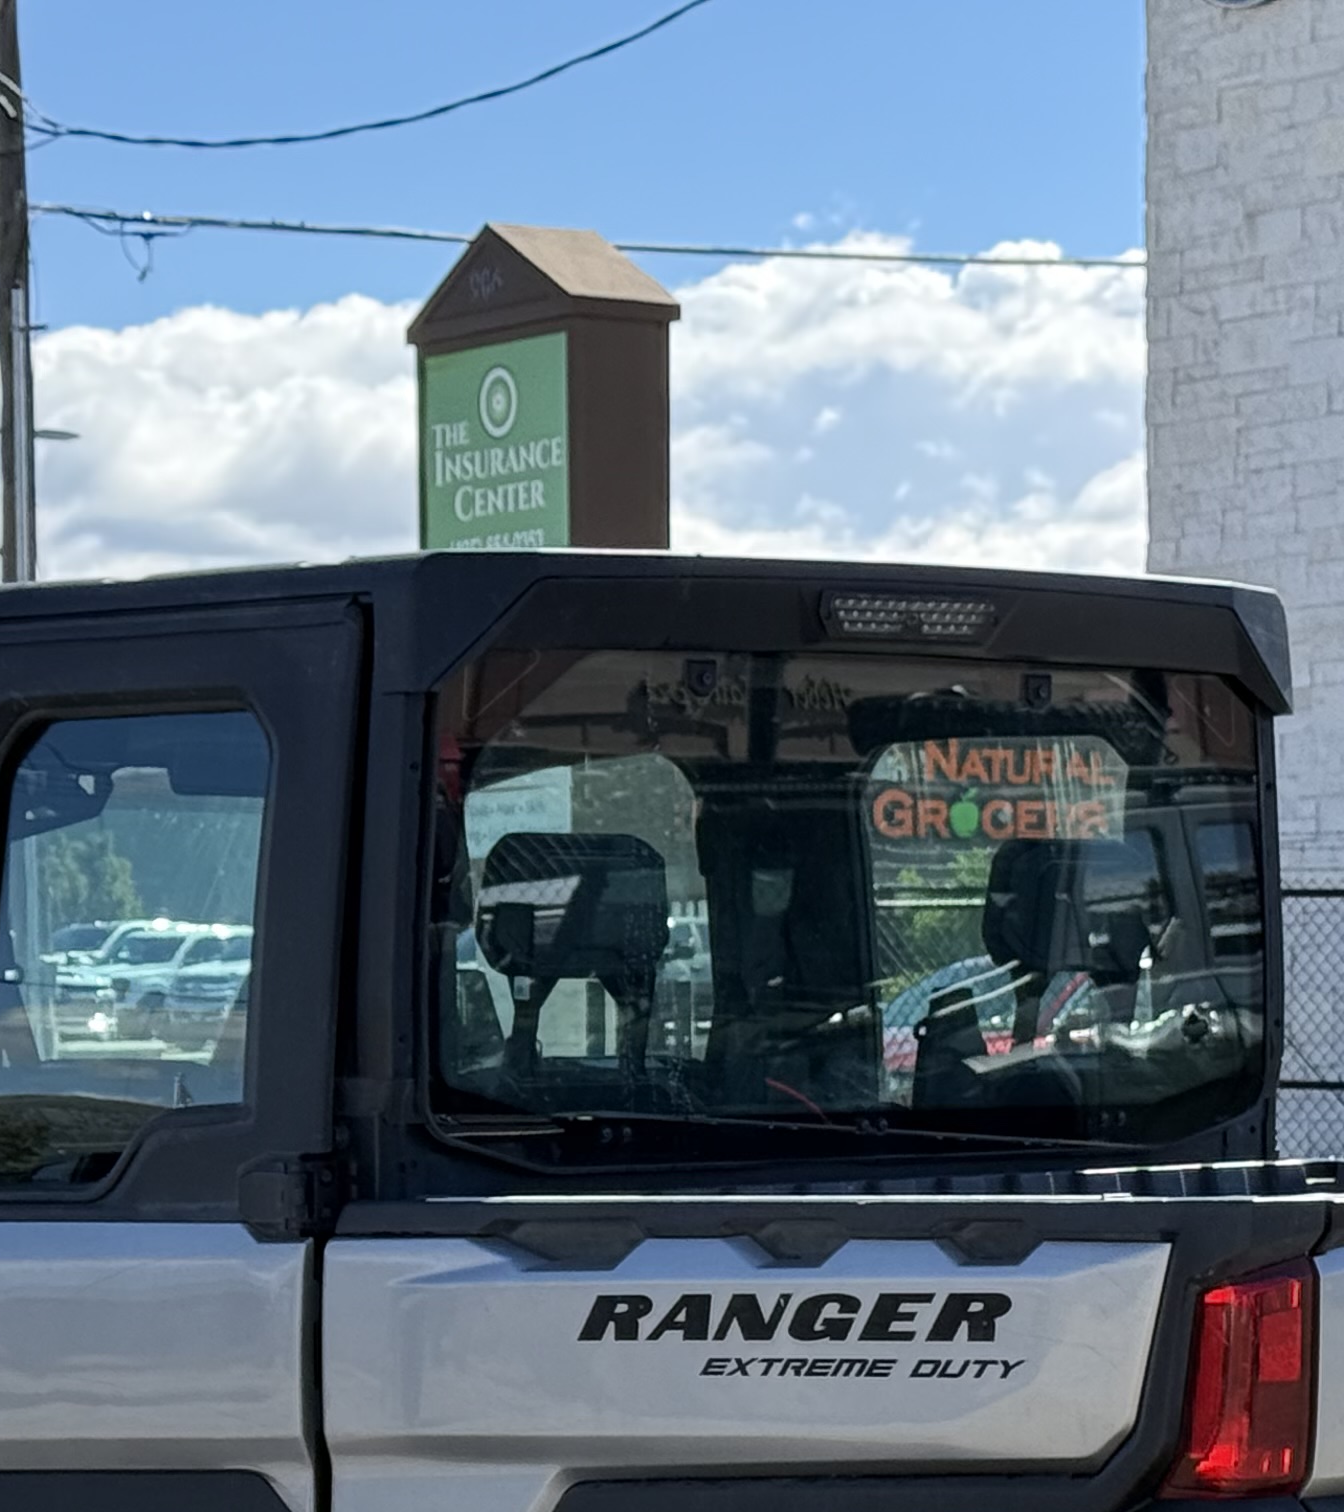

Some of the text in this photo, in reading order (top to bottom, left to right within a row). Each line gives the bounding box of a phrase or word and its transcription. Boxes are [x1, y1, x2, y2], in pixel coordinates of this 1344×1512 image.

[432, 420, 470, 449] THE
[434, 436, 563, 487] INSURANCE
[453, 480, 546, 523] CENTER
[576, 1292, 1013, 1343] RANGER
[699, 1357, 1026, 1379] EXTREME DUTY
